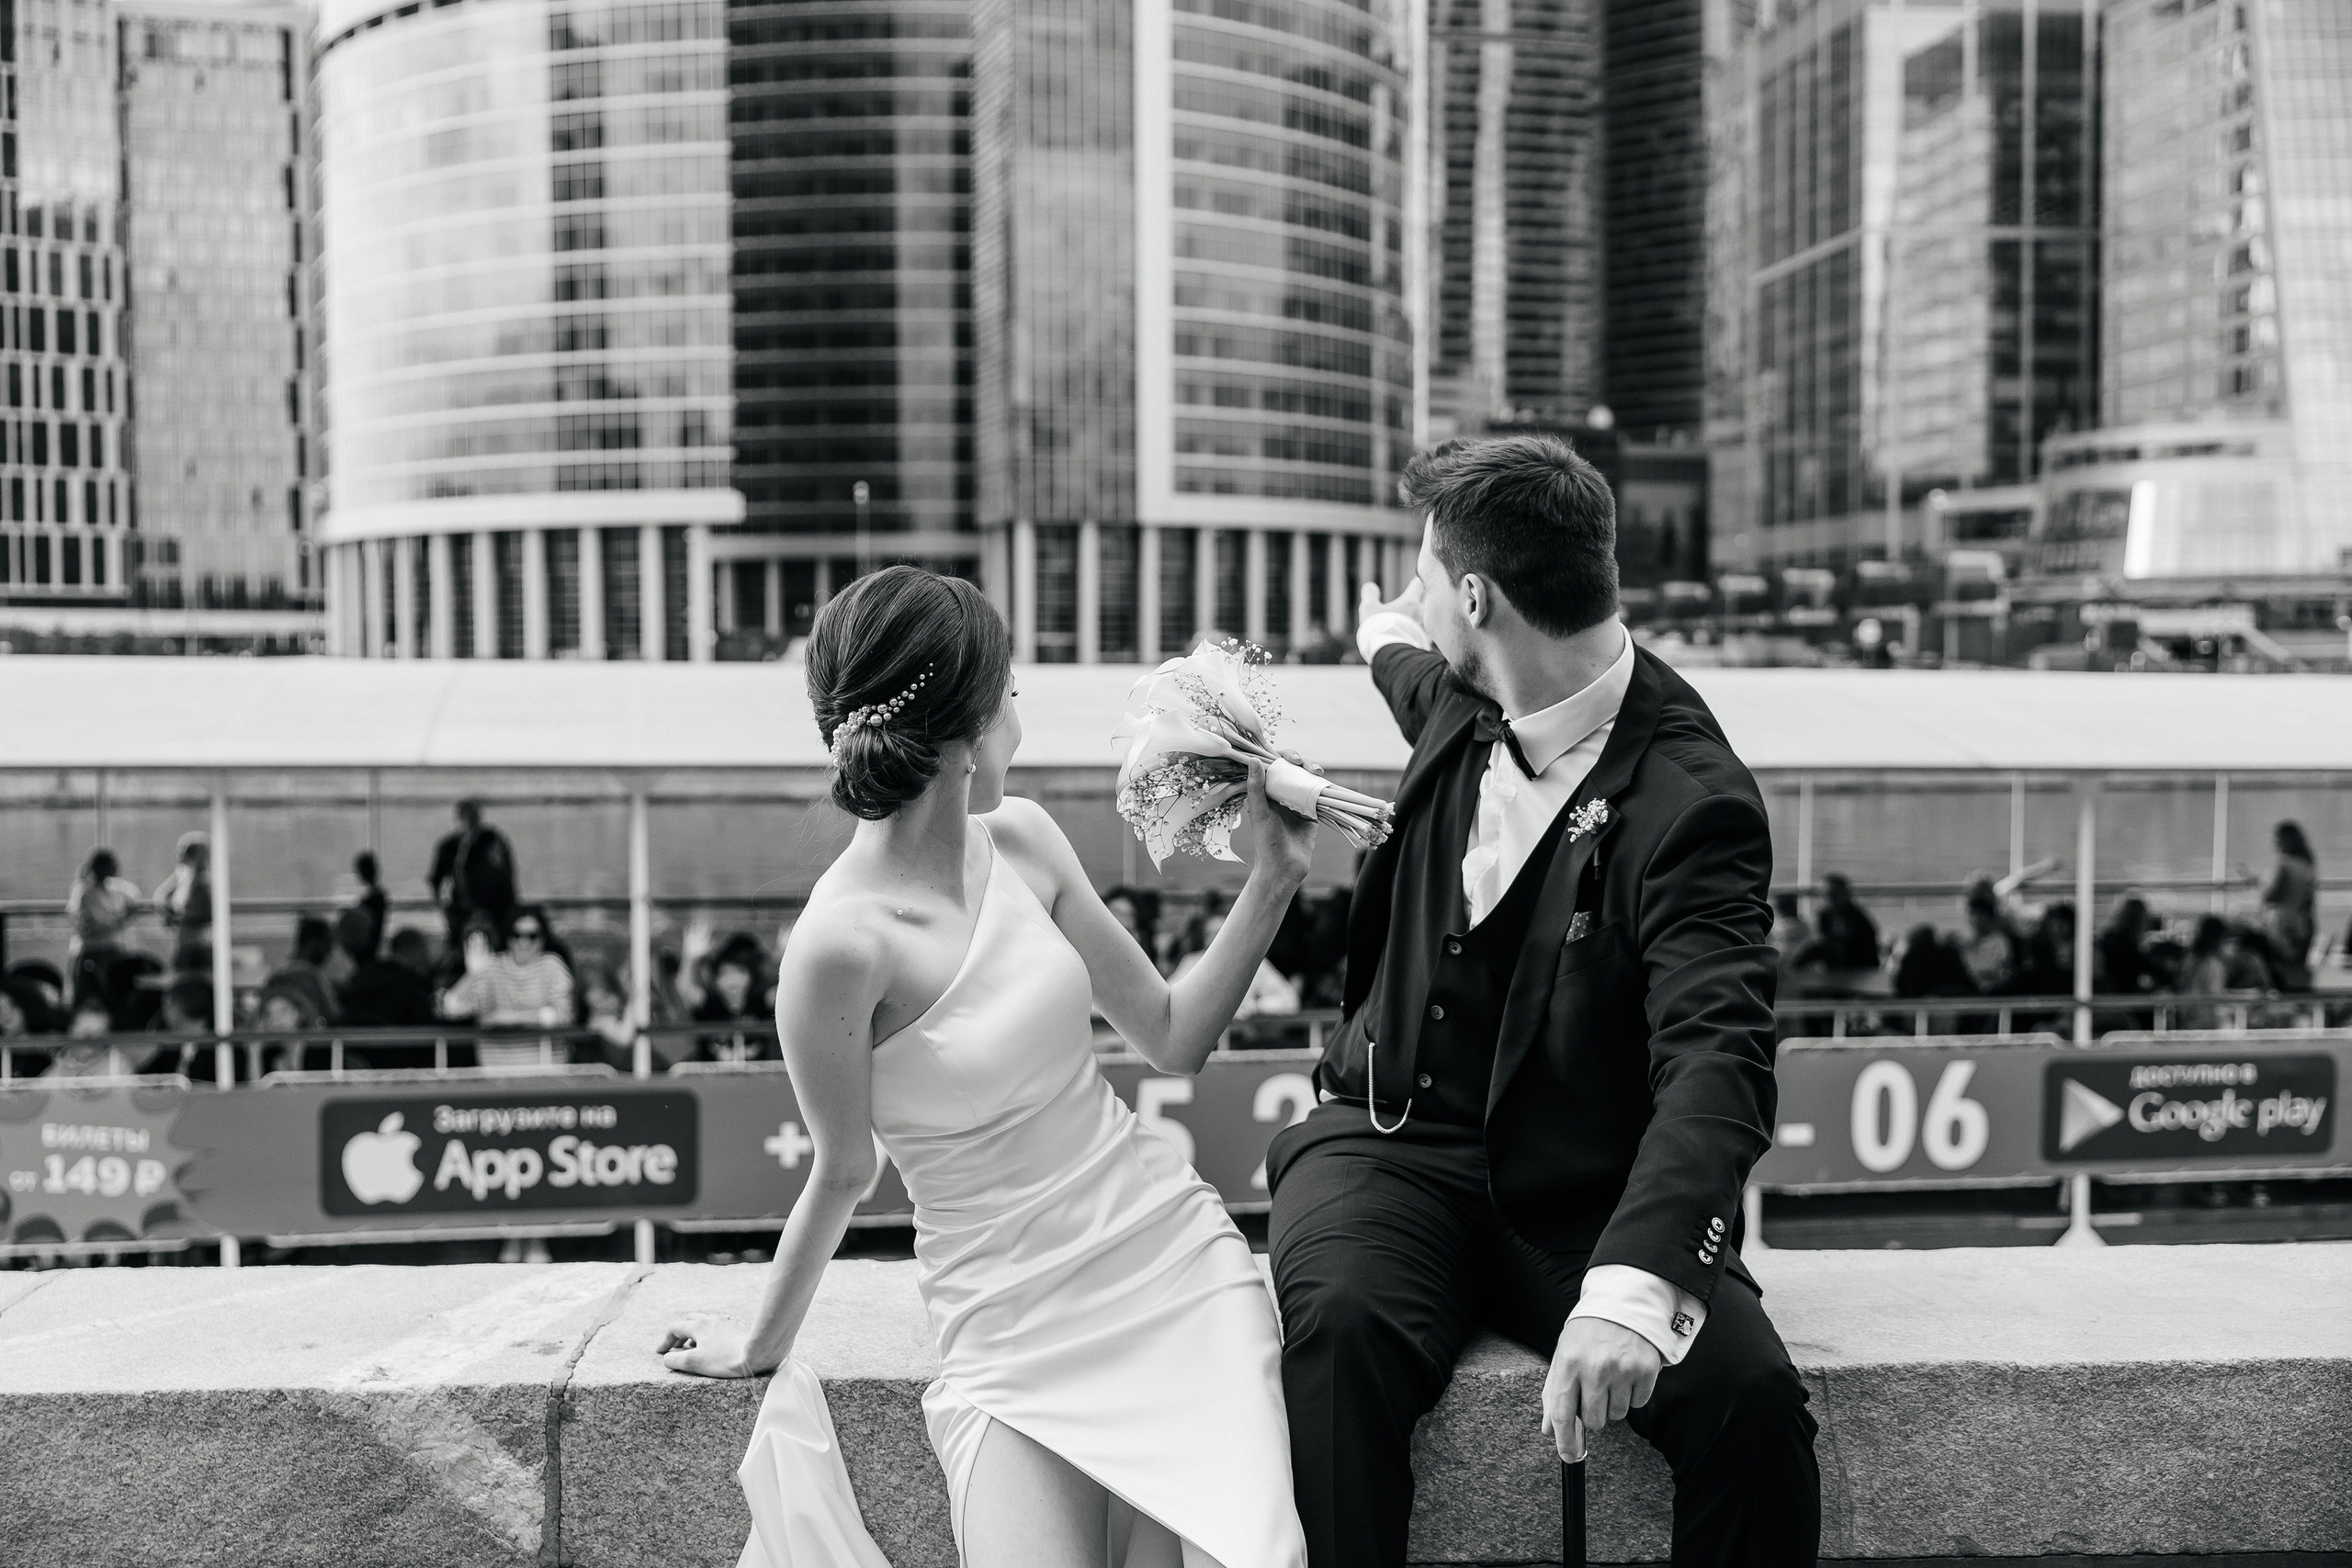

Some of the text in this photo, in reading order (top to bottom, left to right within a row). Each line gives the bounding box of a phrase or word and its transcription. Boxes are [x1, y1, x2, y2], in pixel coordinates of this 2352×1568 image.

[1850, 1059, 1991, 1173] 06
[2128, 1089, 2327, 1142] Google play
[43, 1154, 131, 1197] 149
[434, 1134, 678, 1201] App Store
